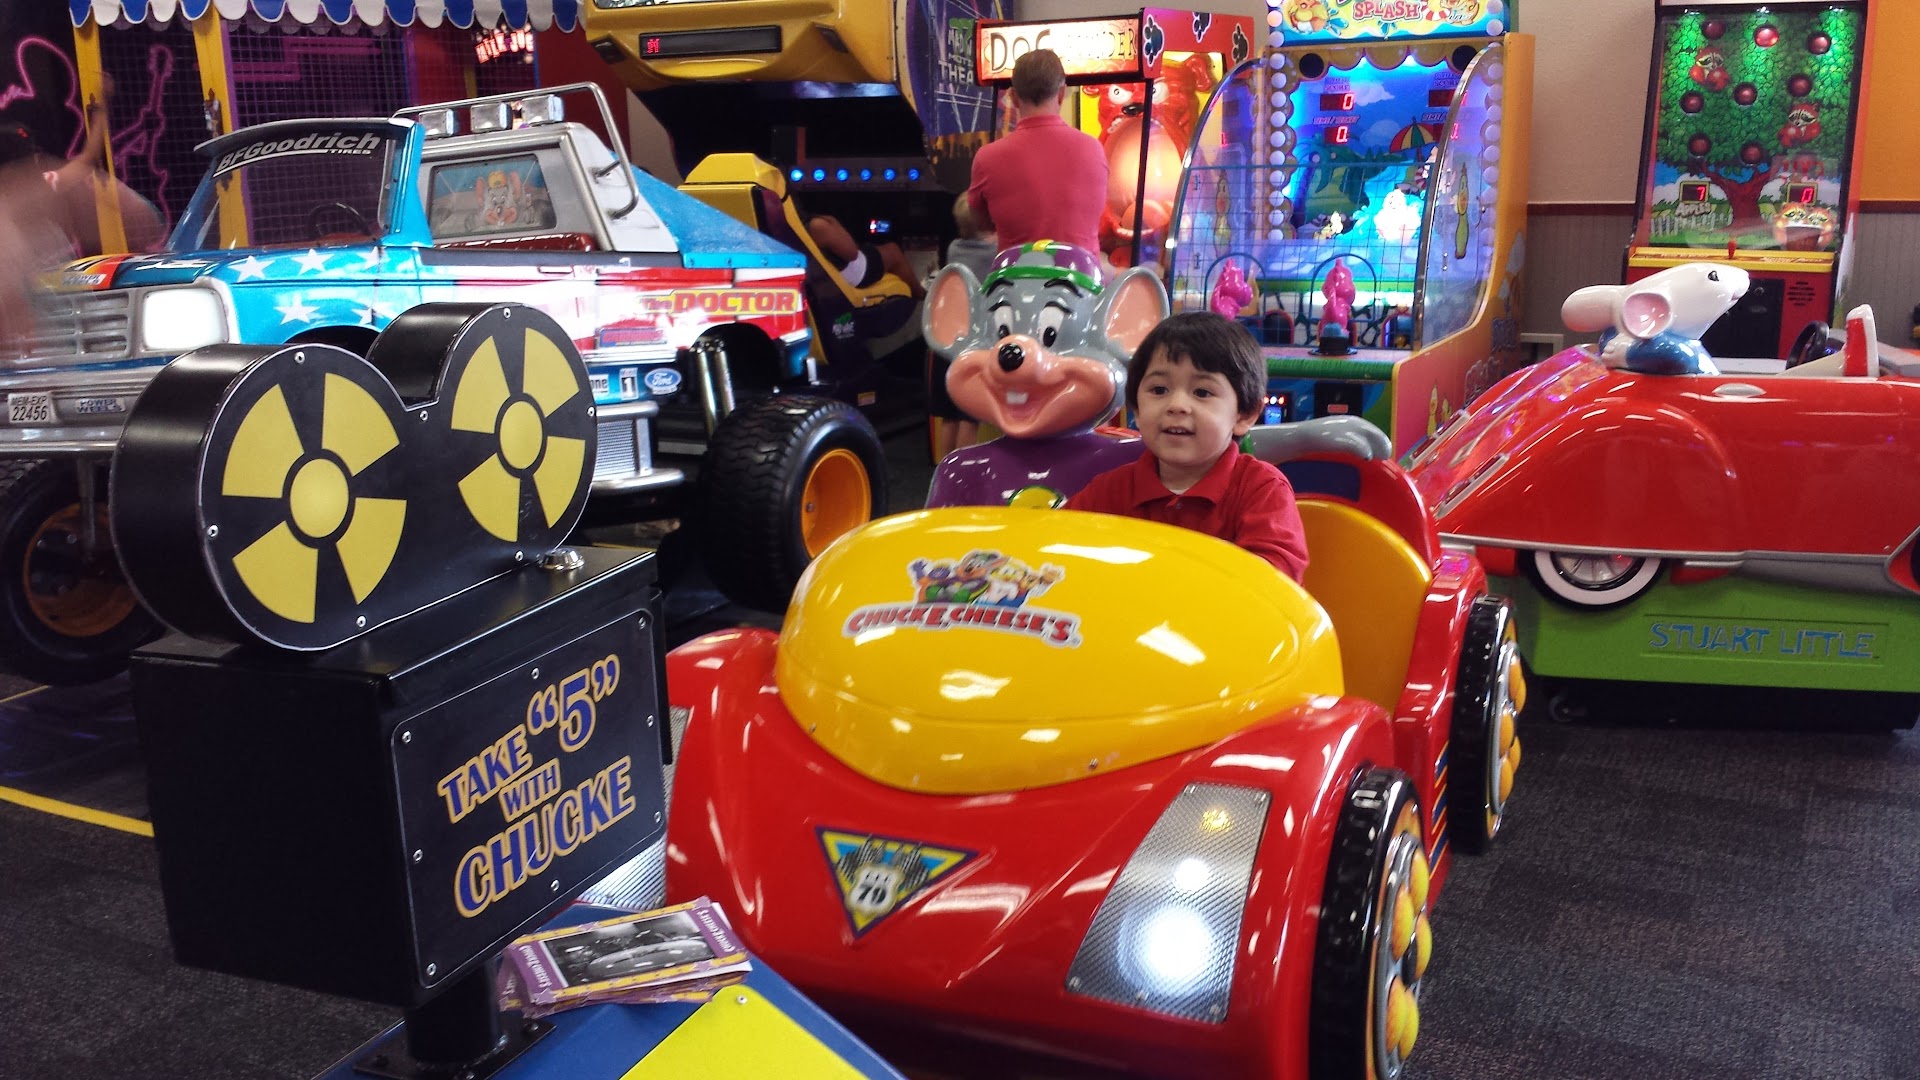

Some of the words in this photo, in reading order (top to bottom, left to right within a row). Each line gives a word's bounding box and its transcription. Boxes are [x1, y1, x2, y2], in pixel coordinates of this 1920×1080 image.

[1353, 0, 1420, 20] SPLASH
[476, 32, 508, 64] MILK
[938, 60, 974, 85] THEA
[1342, 93, 1355, 110] 0
[216, 132, 382, 173] BFGoodrich
[1696, 186, 1706, 201] 7
[1801, 187, 1814, 203] 0
[673, 291, 796, 314] DOCTOR
[651, 371, 674, 386] Ford
[12, 406, 47, 421] 22456
[1649, 623, 1770, 654] STUART
[1779, 628, 1876, 659] LITTLE
[437, 724, 533, 824] TAKE
[499, 757, 561, 822] WITH
[454, 754, 636, 918] CHUCKE
[857, 882, 888, 905] 70
